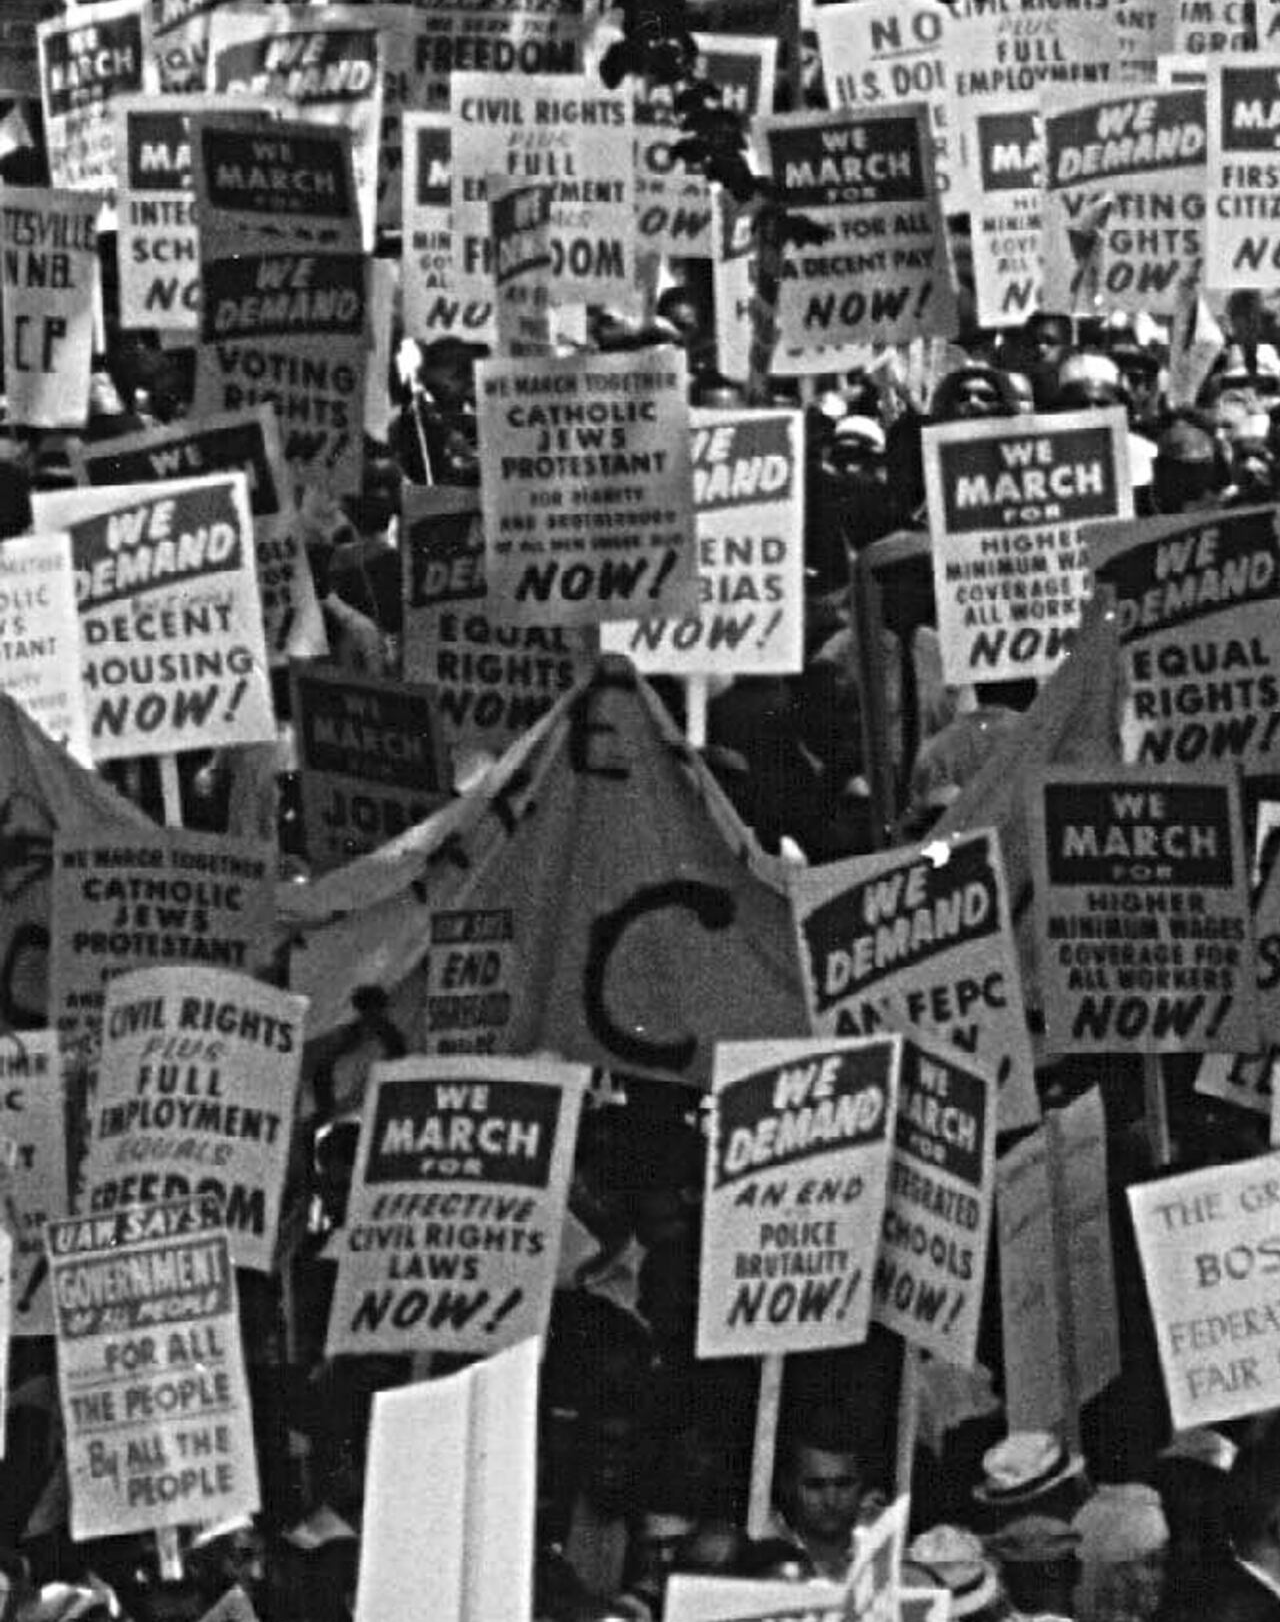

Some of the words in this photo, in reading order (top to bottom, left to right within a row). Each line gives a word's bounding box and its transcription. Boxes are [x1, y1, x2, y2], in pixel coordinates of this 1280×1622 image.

[459, 100, 525, 125] CIVIL
[534, 99, 626, 125] RIGHTS
[506, 151, 574, 175] FULL
[585, 373, 678, 389] TOGETHER
[507, 402, 656, 427] CATHOLIC
[537, 429, 626, 449] JEWS
[502, 453, 667, 478] PROTESTANT
[955, 464, 1103, 506] MARCH
[108, 501, 175, 547] WE
[74, 524, 235, 599] DEMAND
[1154, 528, 1221, 579] WE
[517, 554, 678, 602] NOW!
[1118, 554, 1272, 631] DEMAND
[86, 605, 234, 643] DECENT
[82, 650, 254, 689] HOUSING
[1134, 639, 1270, 680] EQUAL
[93, 682, 247, 736] NOW!
[1134, 680, 1279, 720] RIGHTS
[1063, 825, 1216, 859] MARCH
[1089, 892, 1206, 913] HIGHER
[108, 1000, 166, 1038] CIVIL
[179, 998, 294, 1052] RIGHTS
[1073, 997, 1231, 1038] NOW!
[138, 1066, 221, 1097] FULL
[775, 1059, 841, 1108] WE
[101, 1100, 280, 1143] EMPLOYMENT
[381, 1117, 539, 1157] MARCH
[725, 1086, 882, 1173] DEMAND
[371, 1194, 535, 1221] EFFECTIVE
[735, 1184, 786, 1206] AN
[800, 1179, 862, 1204] END
[1157, 1190, 1218, 1231] THE
[347, 1223, 416, 1252] CIVIL
[425, 1223, 546, 1253] RIGHTS
[761, 1223, 836, 1248] POLICE
[389, 1256, 479, 1279] LAWS
[735, 1250, 847, 1277] BRUTALITY
[350, 1288, 522, 1331] NOW!
[727, 1272, 861, 1326] NOW!
[105, 1337, 154, 1371] FOR
[168, 1329, 223, 1363] ALL
[70, 1392, 114, 1423] THE
[126, 1373, 230, 1418] PEOPLE
[1186, 1363, 1262, 1399] FAIR
